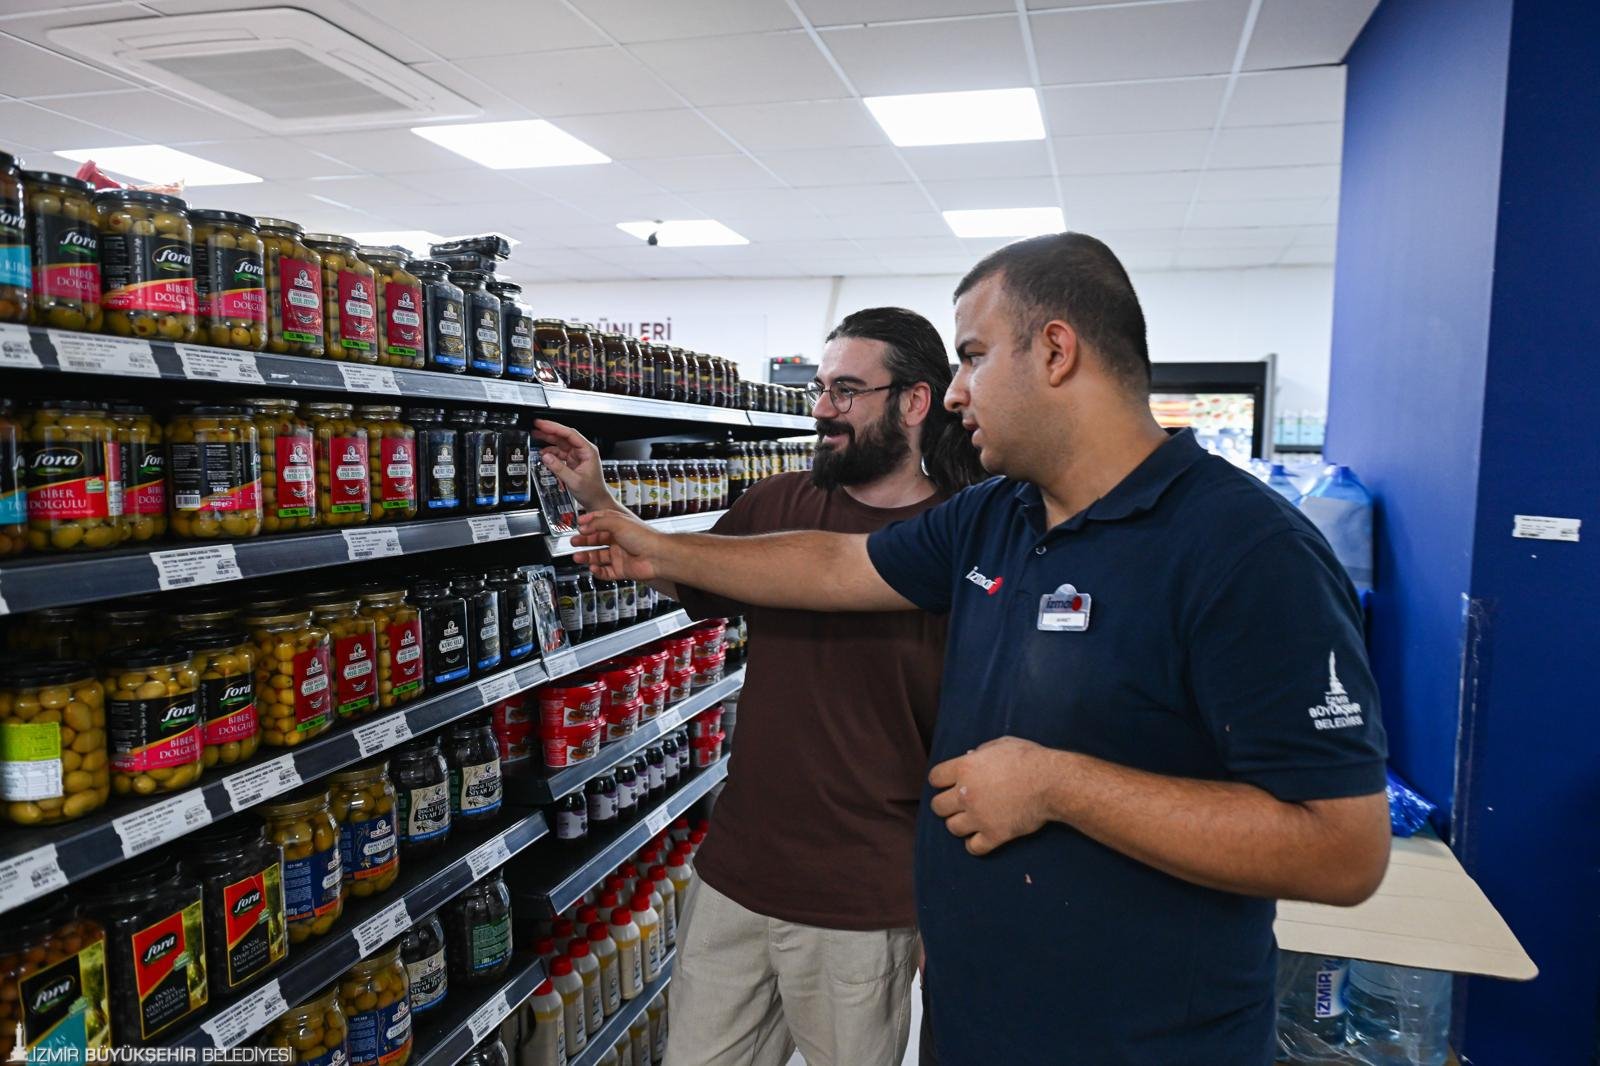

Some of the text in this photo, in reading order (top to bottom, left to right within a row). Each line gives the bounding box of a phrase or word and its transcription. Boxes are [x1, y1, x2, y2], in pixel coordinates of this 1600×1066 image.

[0, 209, 26, 230] ora
[60, 231, 96, 249] fora
[156, 249, 192, 265] fora
[235, 261, 264, 275] fora
[30, 454, 79, 469] fora
[140, 455, 164, 468] for
[40, 488, 74, 499] BİBER
[29, 499, 87, 510] DOLGULU
[220, 684, 251, 701] fora
[161, 703, 196, 722] fora
[228, 713, 250, 725] BİBER
[170, 735, 195, 748] BİBER
[234, 891, 261, 914] fora
[144, 934, 176, 962] fora
